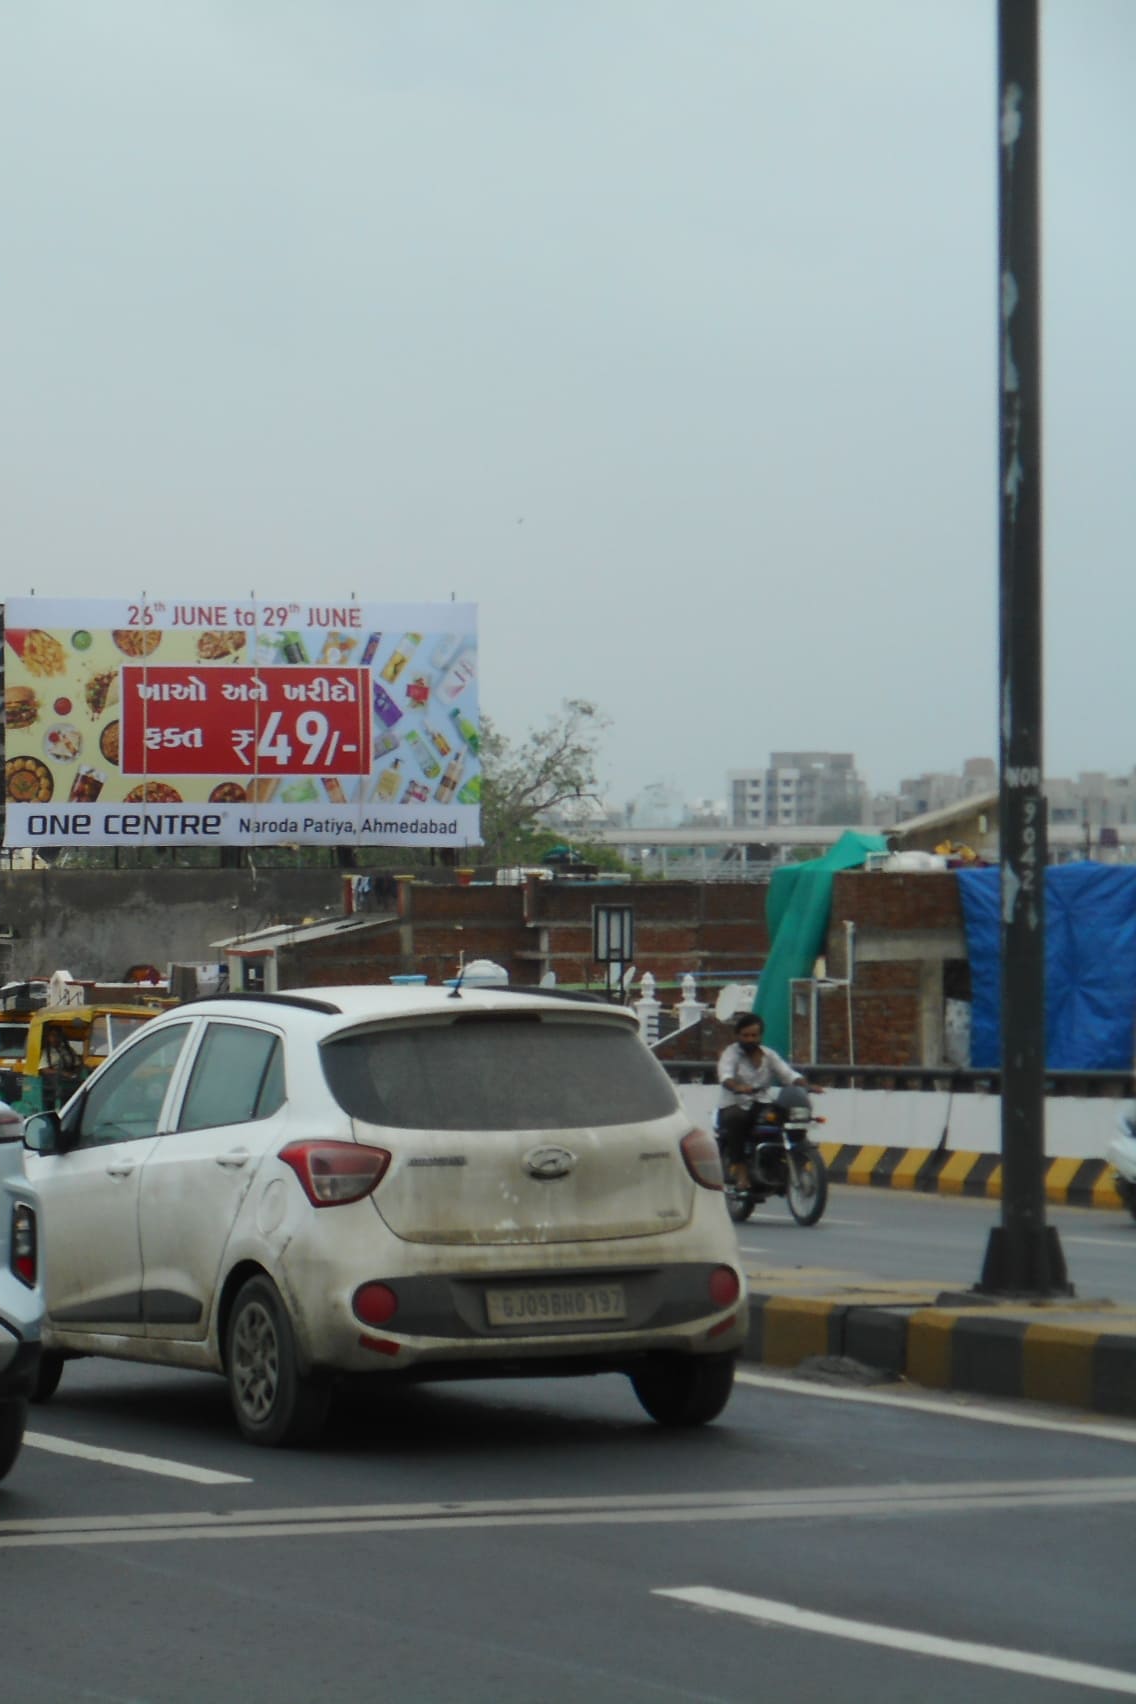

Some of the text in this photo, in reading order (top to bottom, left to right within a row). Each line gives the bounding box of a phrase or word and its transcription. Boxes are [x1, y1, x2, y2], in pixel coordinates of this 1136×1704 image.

[127, 602, 362, 628] 26th JUNE to 29th JUNE
[137, 676, 356, 702] ખાઓ અને ખરીદો
[239, 817, 298, 834] Naroda
[303, 818, 357, 836] Patiya,
[361, 818, 457, 835] Ahmedabad
